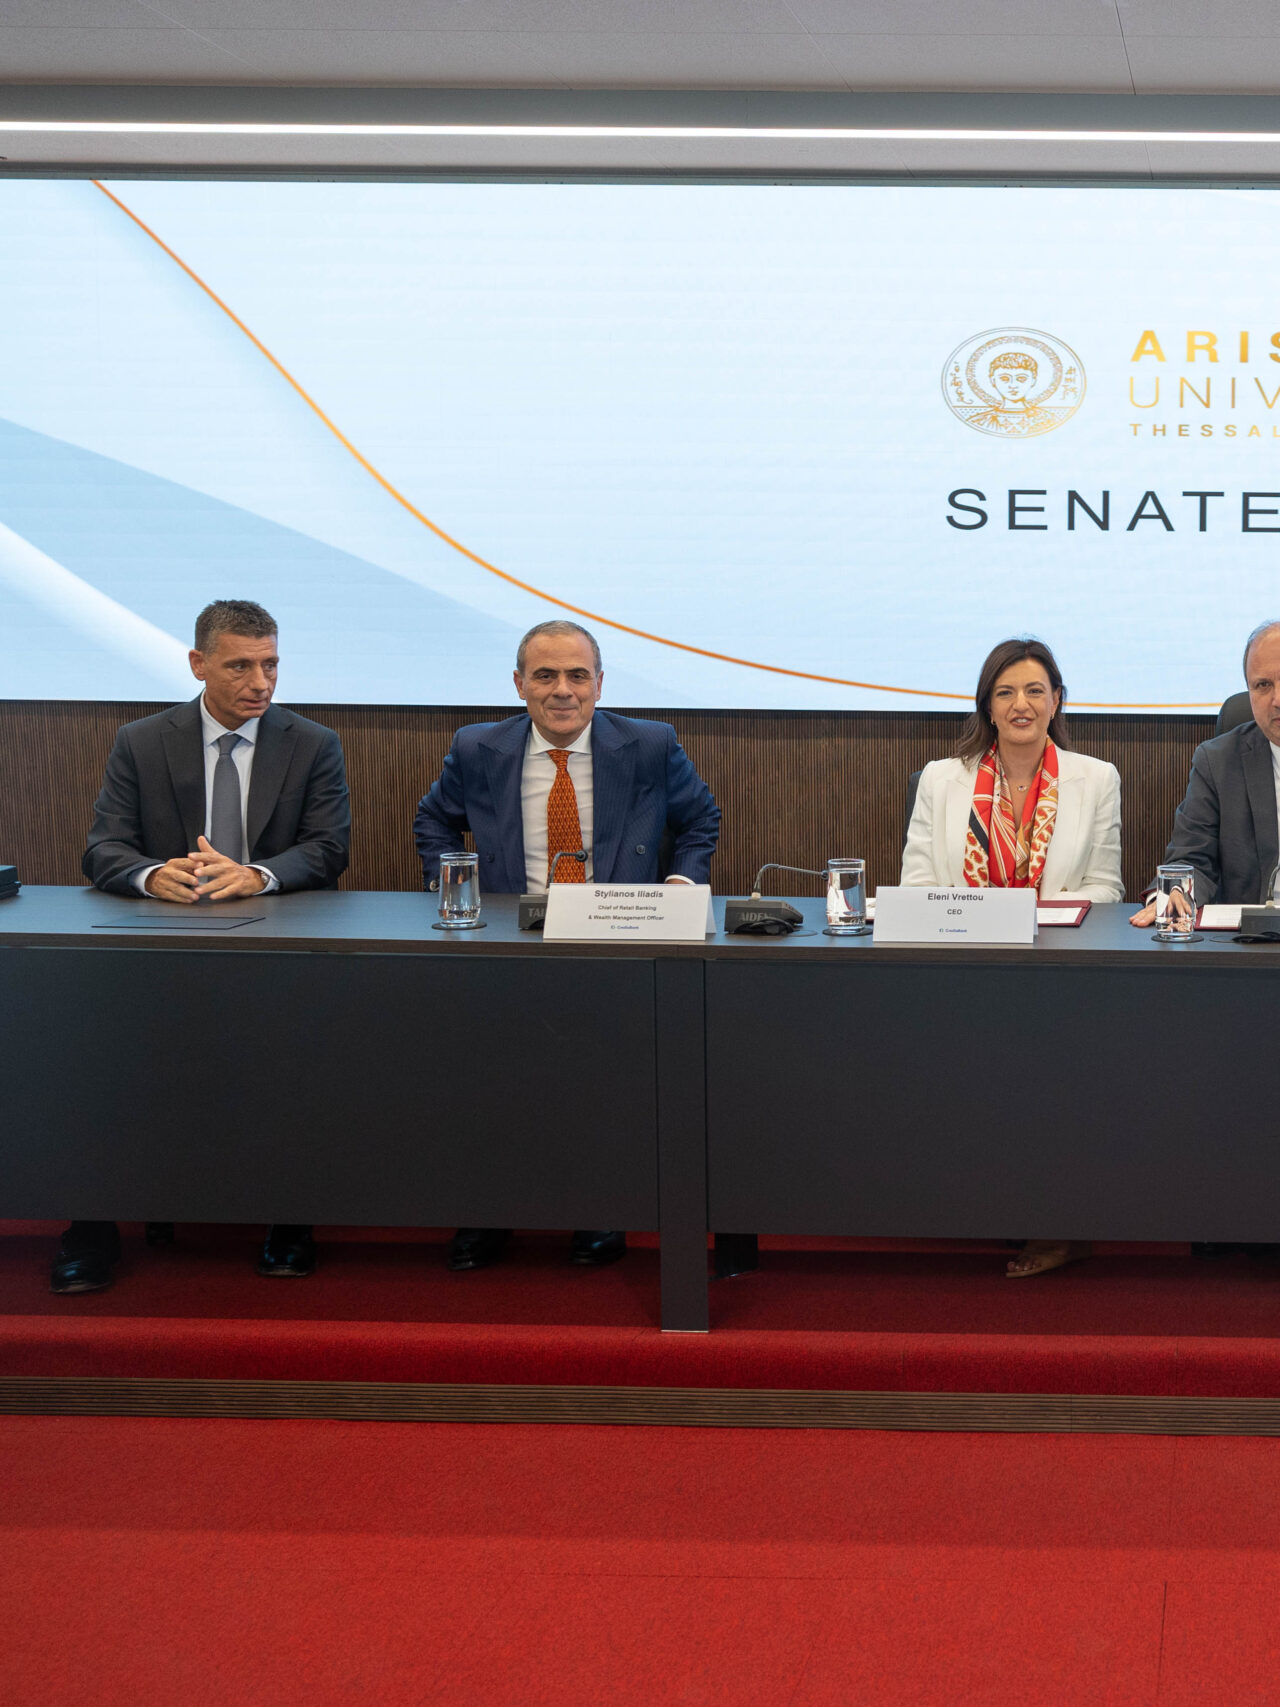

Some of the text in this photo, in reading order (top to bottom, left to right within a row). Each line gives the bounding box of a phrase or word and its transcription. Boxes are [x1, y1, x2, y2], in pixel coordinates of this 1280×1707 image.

[594, 889, 664, 899] Stylianos Iliadis
[927, 893, 984, 901] Eleni Vrettou
